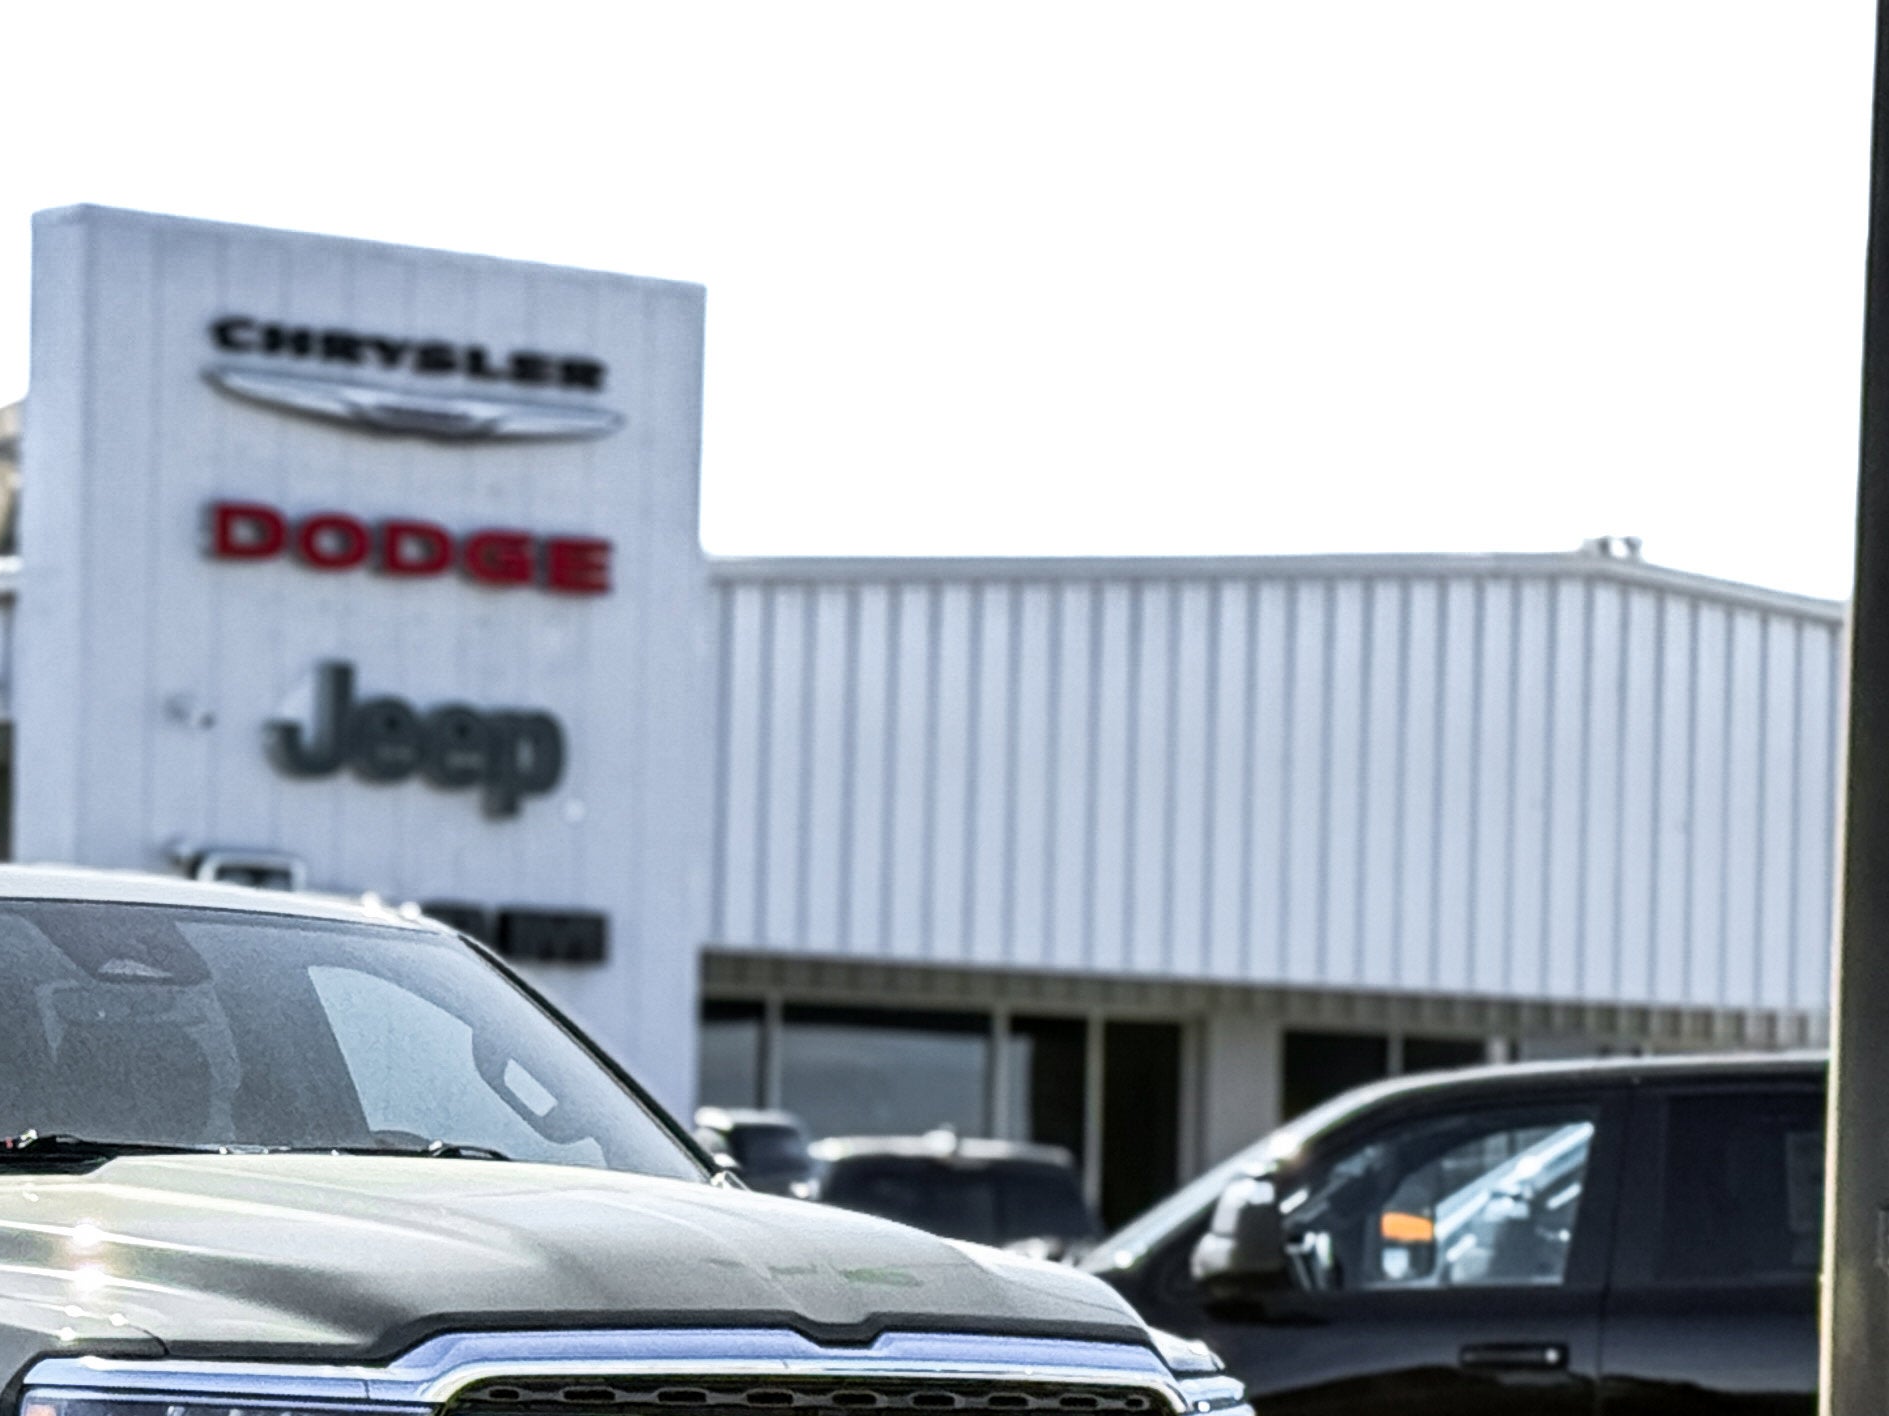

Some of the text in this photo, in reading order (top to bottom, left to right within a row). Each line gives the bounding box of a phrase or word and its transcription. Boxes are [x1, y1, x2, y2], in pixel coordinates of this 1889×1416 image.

[209, 314, 607, 391] CHRYSLER
[208, 500, 614, 596] DODGE
[264, 660, 568, 821] Jeep
